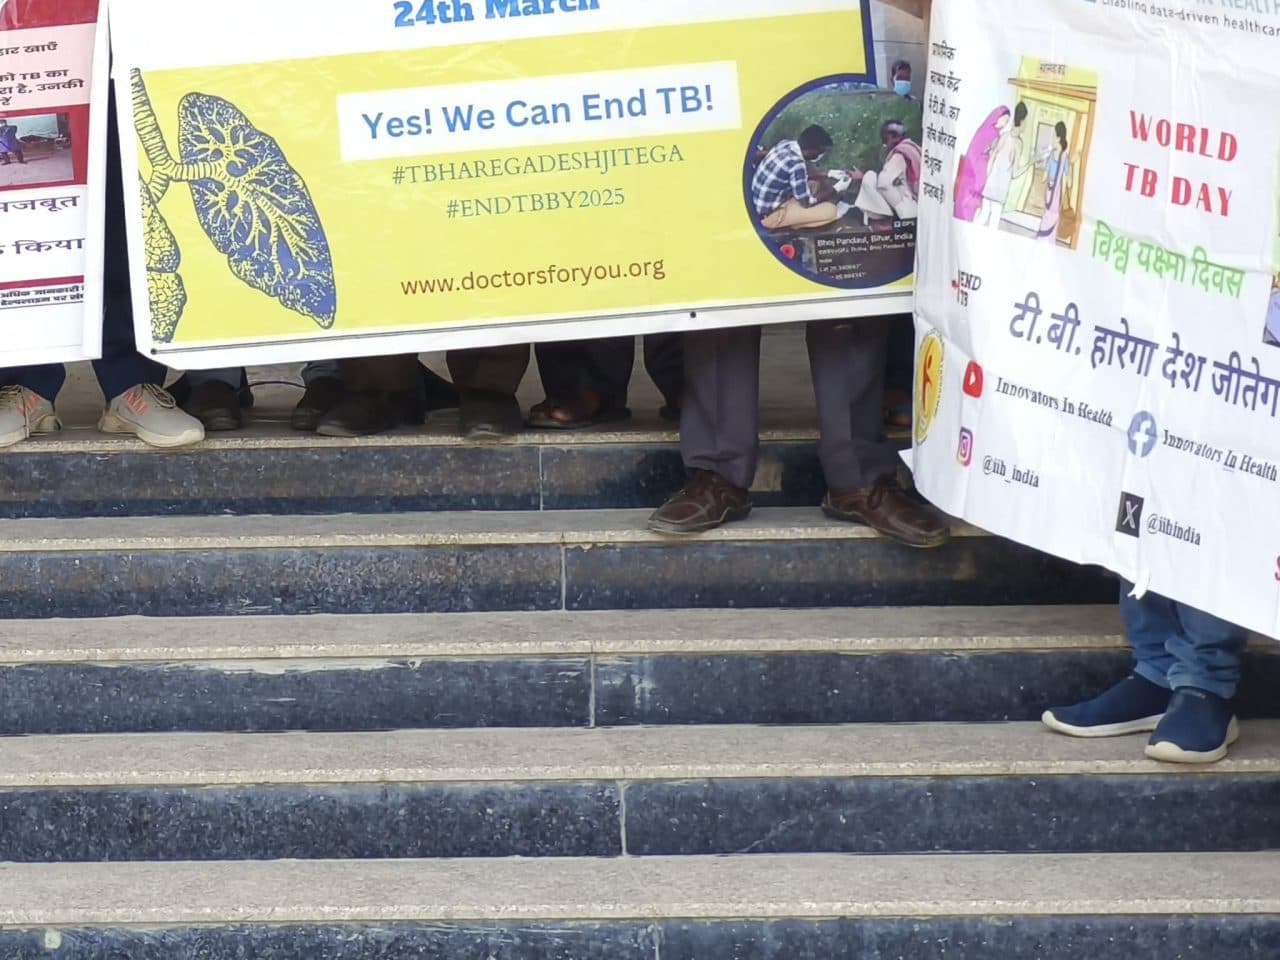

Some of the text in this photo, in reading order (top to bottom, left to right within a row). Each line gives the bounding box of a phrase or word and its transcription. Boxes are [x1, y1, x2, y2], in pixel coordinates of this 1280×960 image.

[1150, 4, 1219, 25] data-driven
[360, 82, 714, 140] Yes! We Can End TB!
[1130, 110, 1238, 163] WORLD
[390, 144, 686, 187] #TBHAREGADESHJITEGA
[1123, 162, 1233, 217] TB DAY
[445, 186, 625, 221] #ENDTBBY2025
[399, 254, 667, 297] www.doctorsforyou.org
[1091, 220, 1246, 299] विश्व यक्ष्मा दिवस
[1009, 292, 1081, 356] टी.बी.
[1090, 318, 1159, 377] हारेगा
[1162, 332, 1207, 392] देश
[995, 377, 1114, 428] Innovators In Health
[982, 455, 1040, 488] @iih_india
[1163, 429, 1278, 483] Innovators In Health
[1147, 513, 1202, 546] @iihindia
